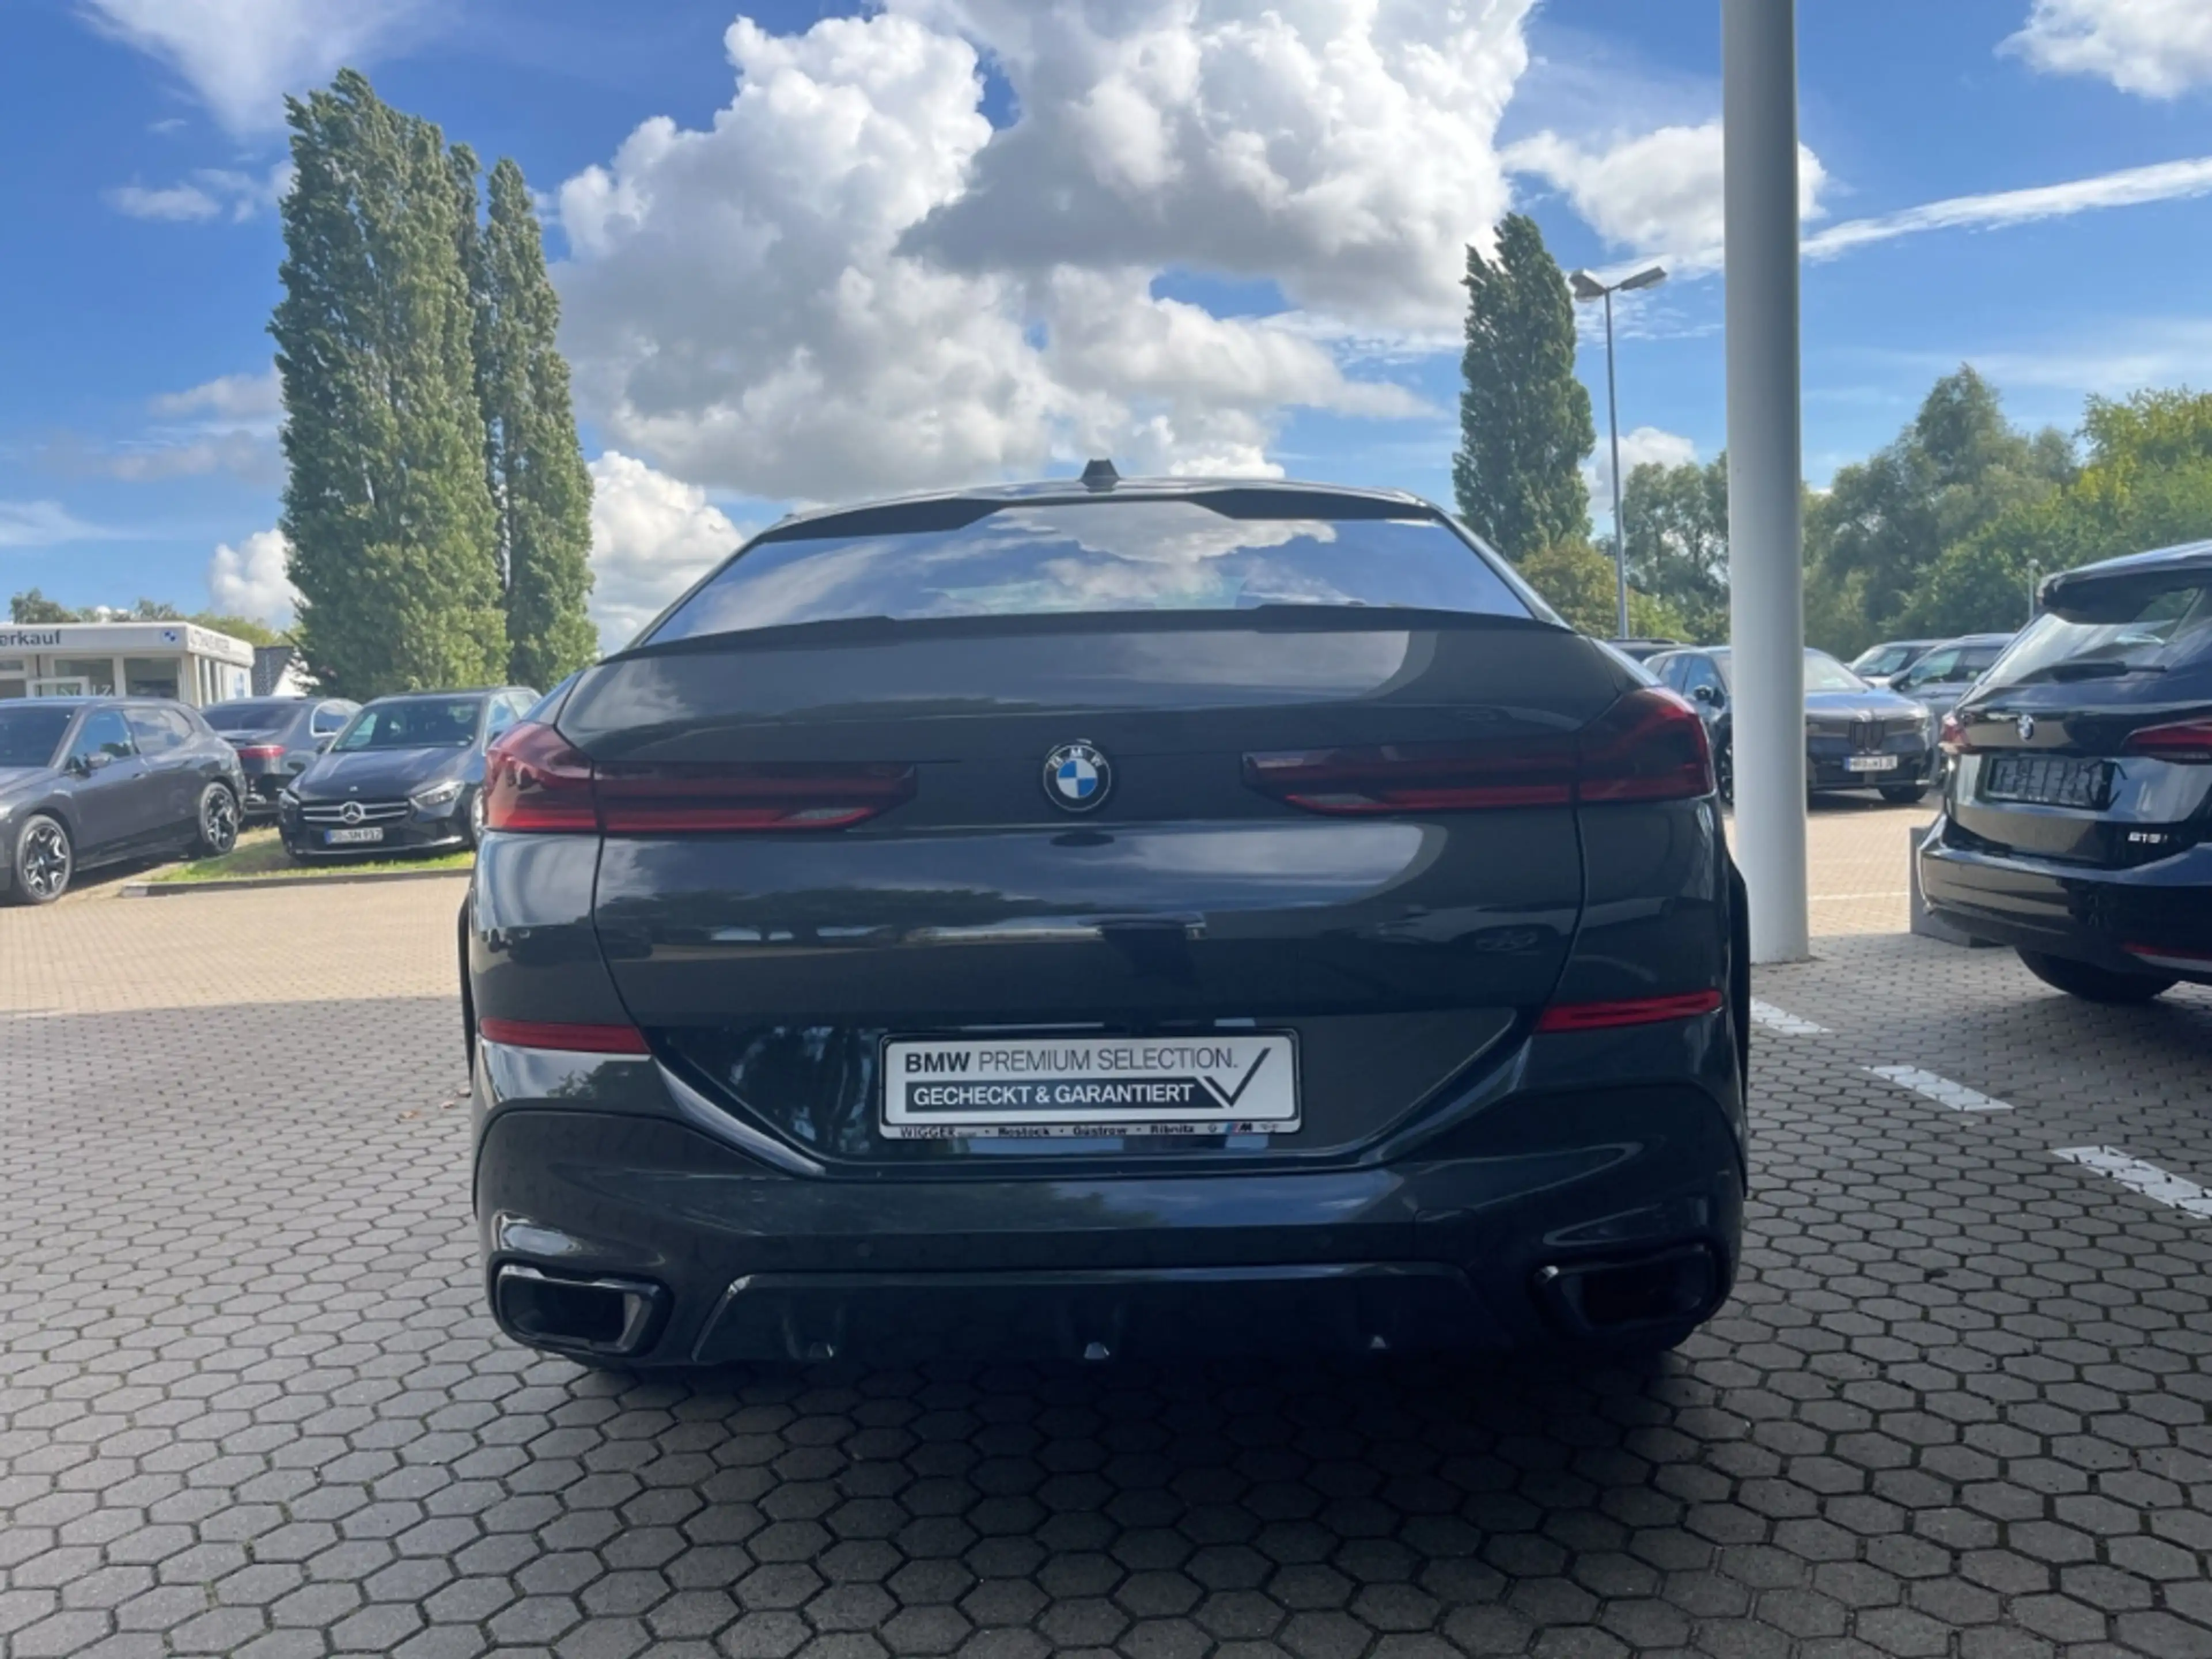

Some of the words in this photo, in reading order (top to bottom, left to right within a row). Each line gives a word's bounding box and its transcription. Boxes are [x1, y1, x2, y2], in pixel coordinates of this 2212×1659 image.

[905, 1051, 971, 1073] BMW
[979, 1049, 1090, 1072] PREMIUM
[1097, 1047, 1238, 1071] SELECTION.
[913, 1086, 1032, 1105] GECHECKT
[1035, 1085, 1050, 1104] &
[1054, 1084, 1195, 1104] GARANTIERT
[901, 1126, 957, 1138] WIGGER
